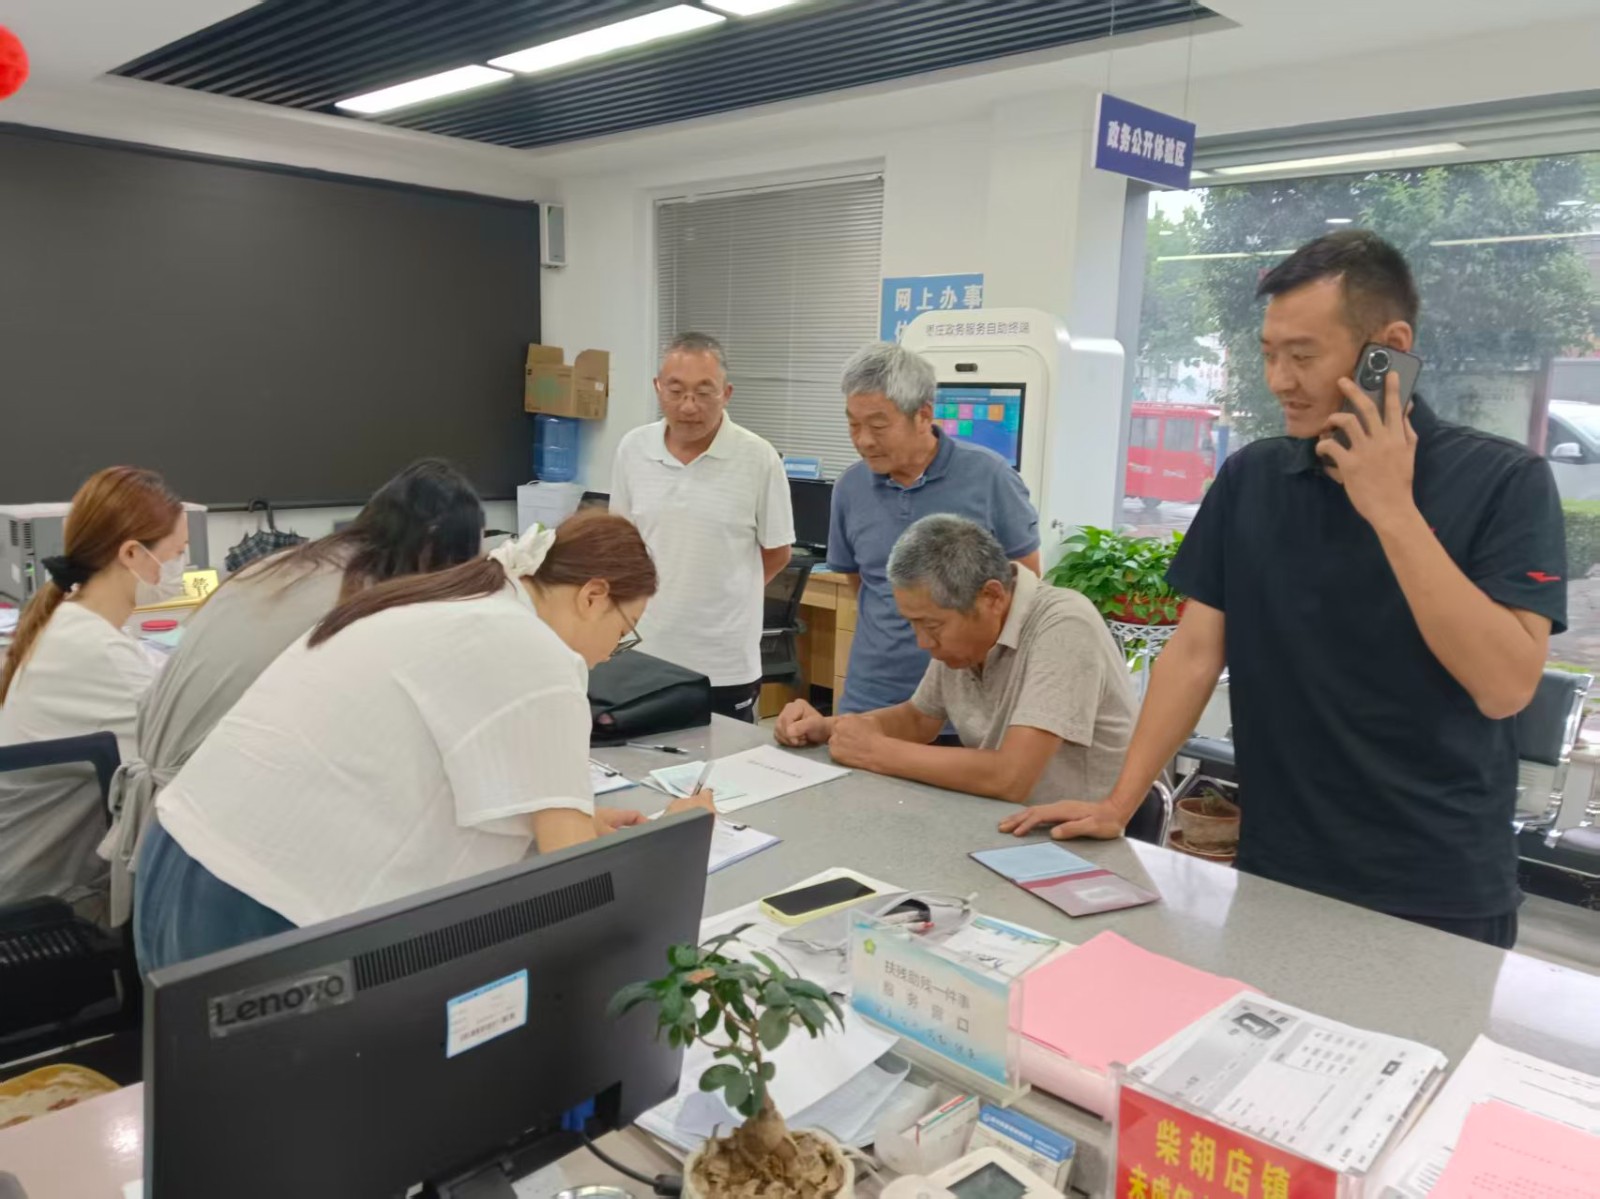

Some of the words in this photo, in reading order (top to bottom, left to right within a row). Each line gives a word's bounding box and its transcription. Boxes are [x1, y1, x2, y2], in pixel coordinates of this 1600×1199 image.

[1106, 120, 1187, 167] 政务公开体验区
[895, 284, 982, 311] 网上办事
[926, 322, 1030, 336] 枣庄政务服务自助终端
[1155, 1118, 1291, 1199] 柴胡店镇
